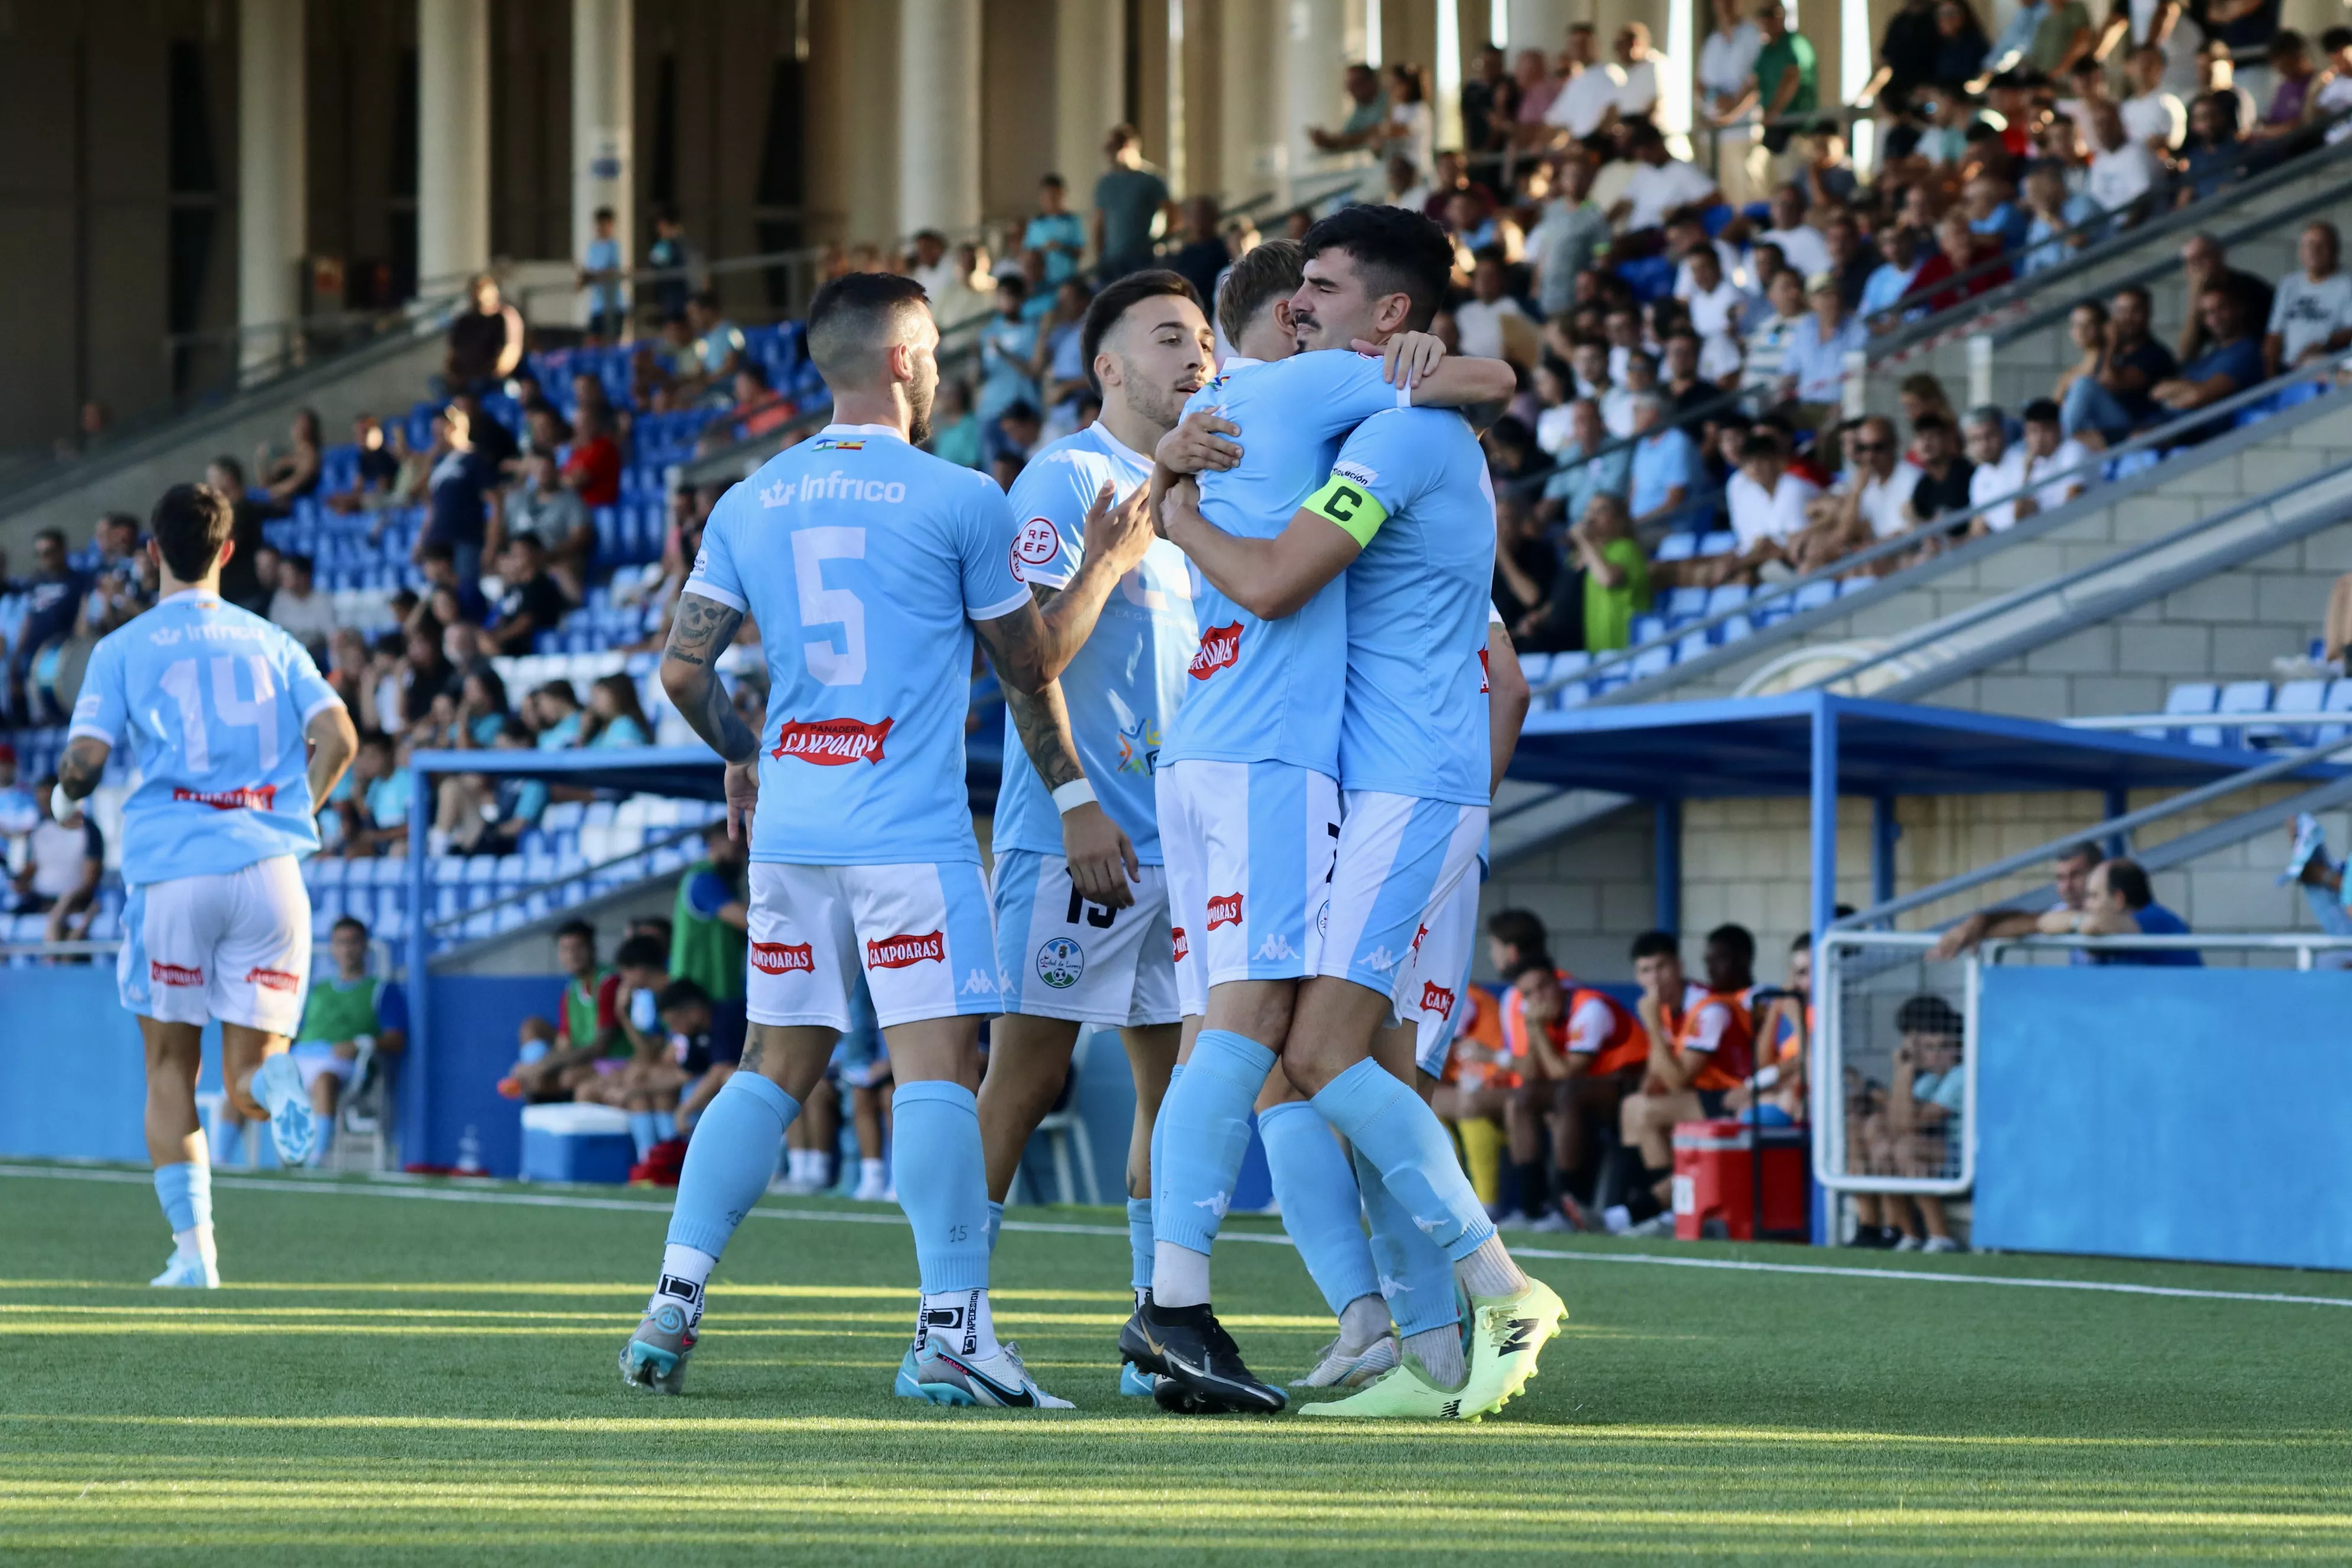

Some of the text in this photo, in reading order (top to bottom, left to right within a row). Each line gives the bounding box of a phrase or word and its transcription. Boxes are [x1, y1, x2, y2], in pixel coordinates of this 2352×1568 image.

[800, 470, 906, 502] Infrico
[1324, 486, 1363, 521] C
[790, 525, 867, 687] 5
[159, 655, 280, 773] 14
[810, 724, 865, 733] PANADERIA
[870, 940, 939, 965] CAMPOARAS
[949, 1225, 968, 1243] 15
[966, 1290, 980, 1335] TAPEDESIGN
[942, 1355, 968, 1374] TIEMPO
